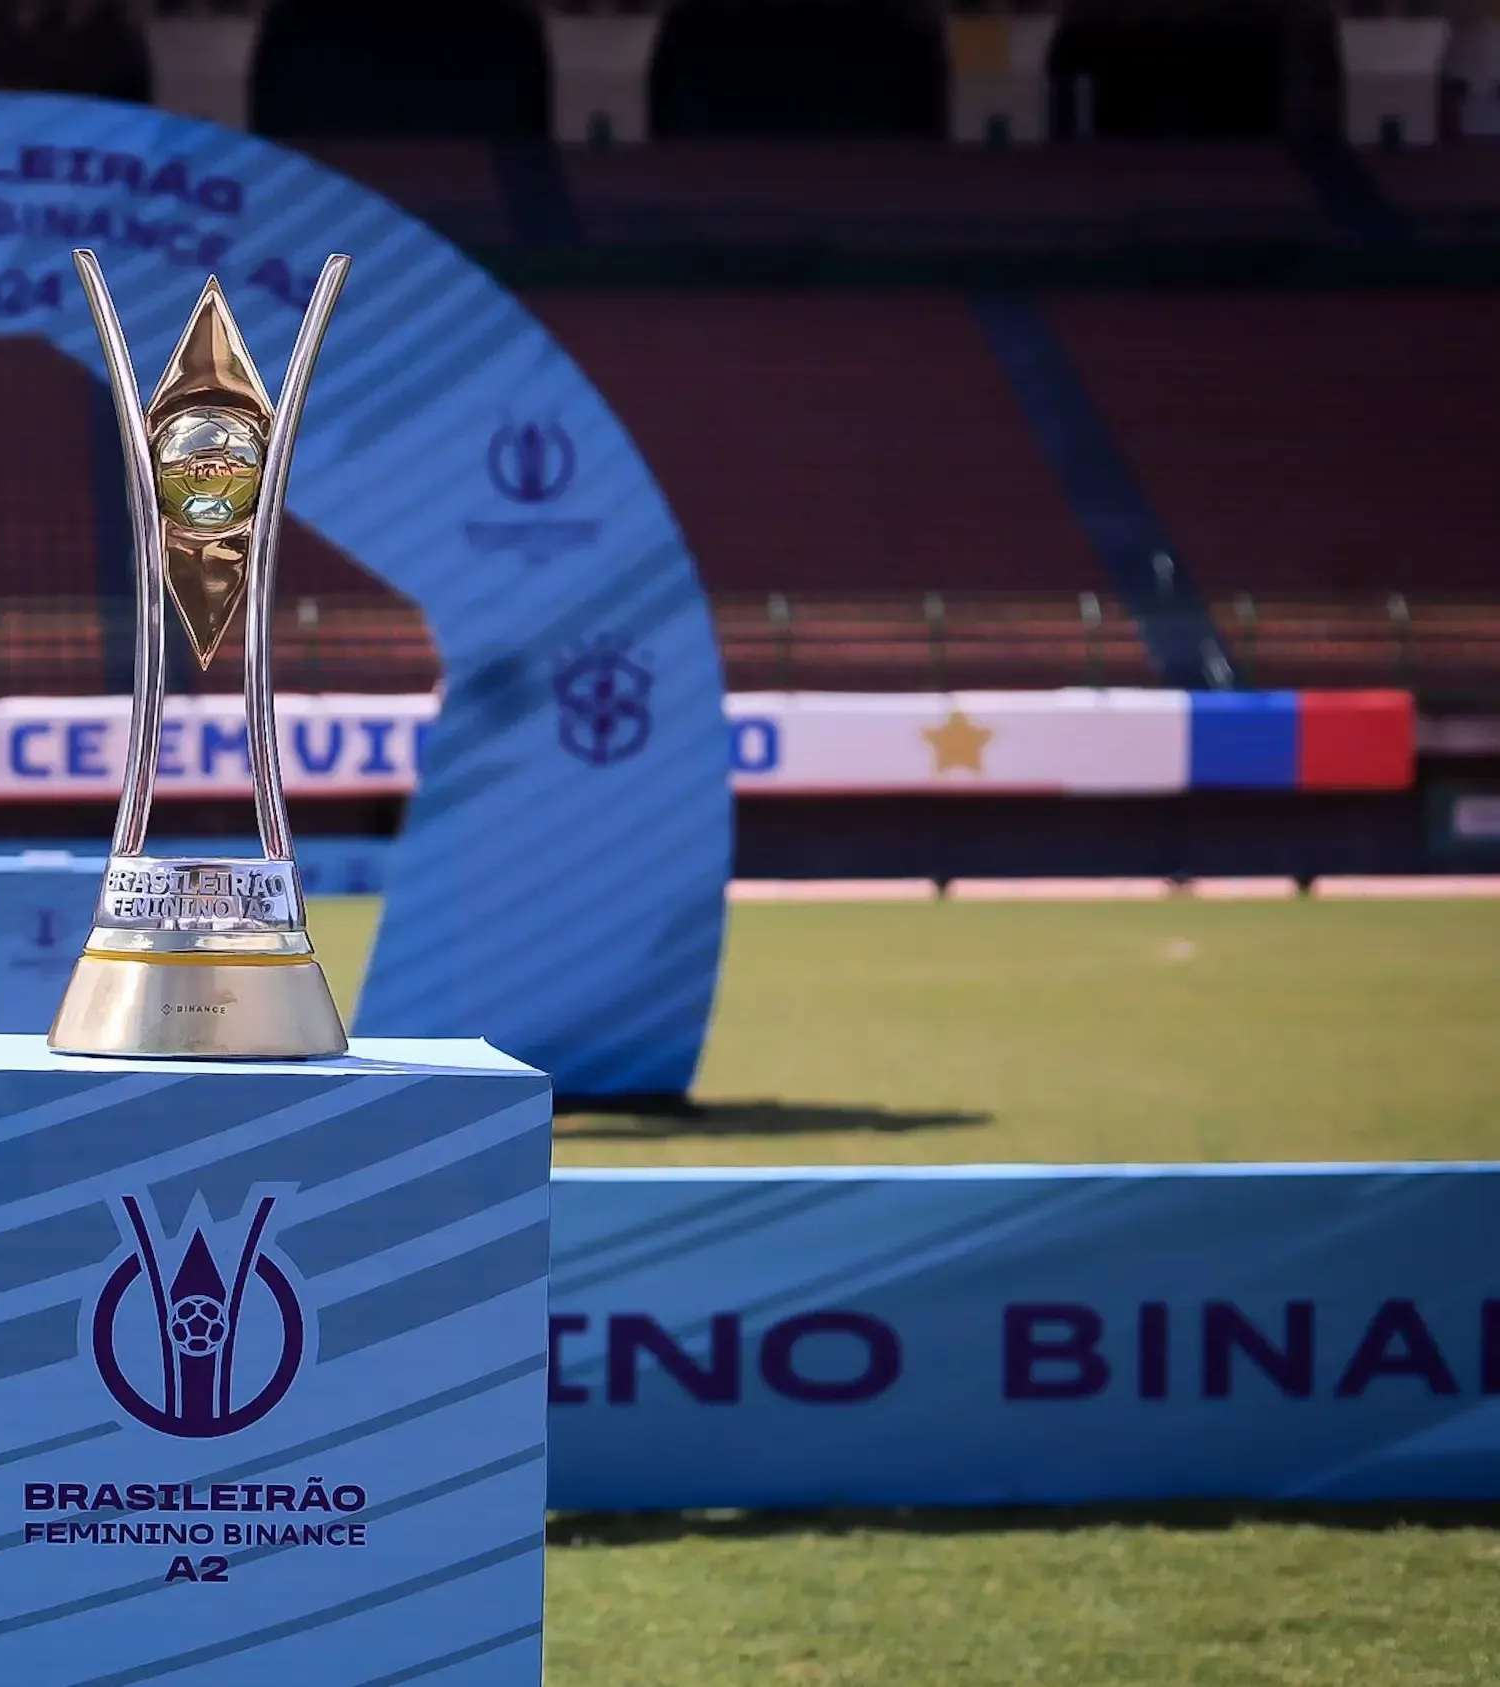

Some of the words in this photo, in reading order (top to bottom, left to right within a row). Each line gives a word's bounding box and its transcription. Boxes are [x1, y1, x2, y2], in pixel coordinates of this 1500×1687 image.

[108, 866, 285, 897] BRASILEIRÃO
[113, 897, 236, 920] FEMININO
[247, 897, 277, 919] A2
[176, 1005, 227, 1015] BINANCE
[23, 1476, 367, 1512] BRASILEIRÃO
[24, 1522, 215, 1545] FEMININO
[222, 1523, 366, 1547] BINANCE
[164, 1555, 229, 1582] A2
